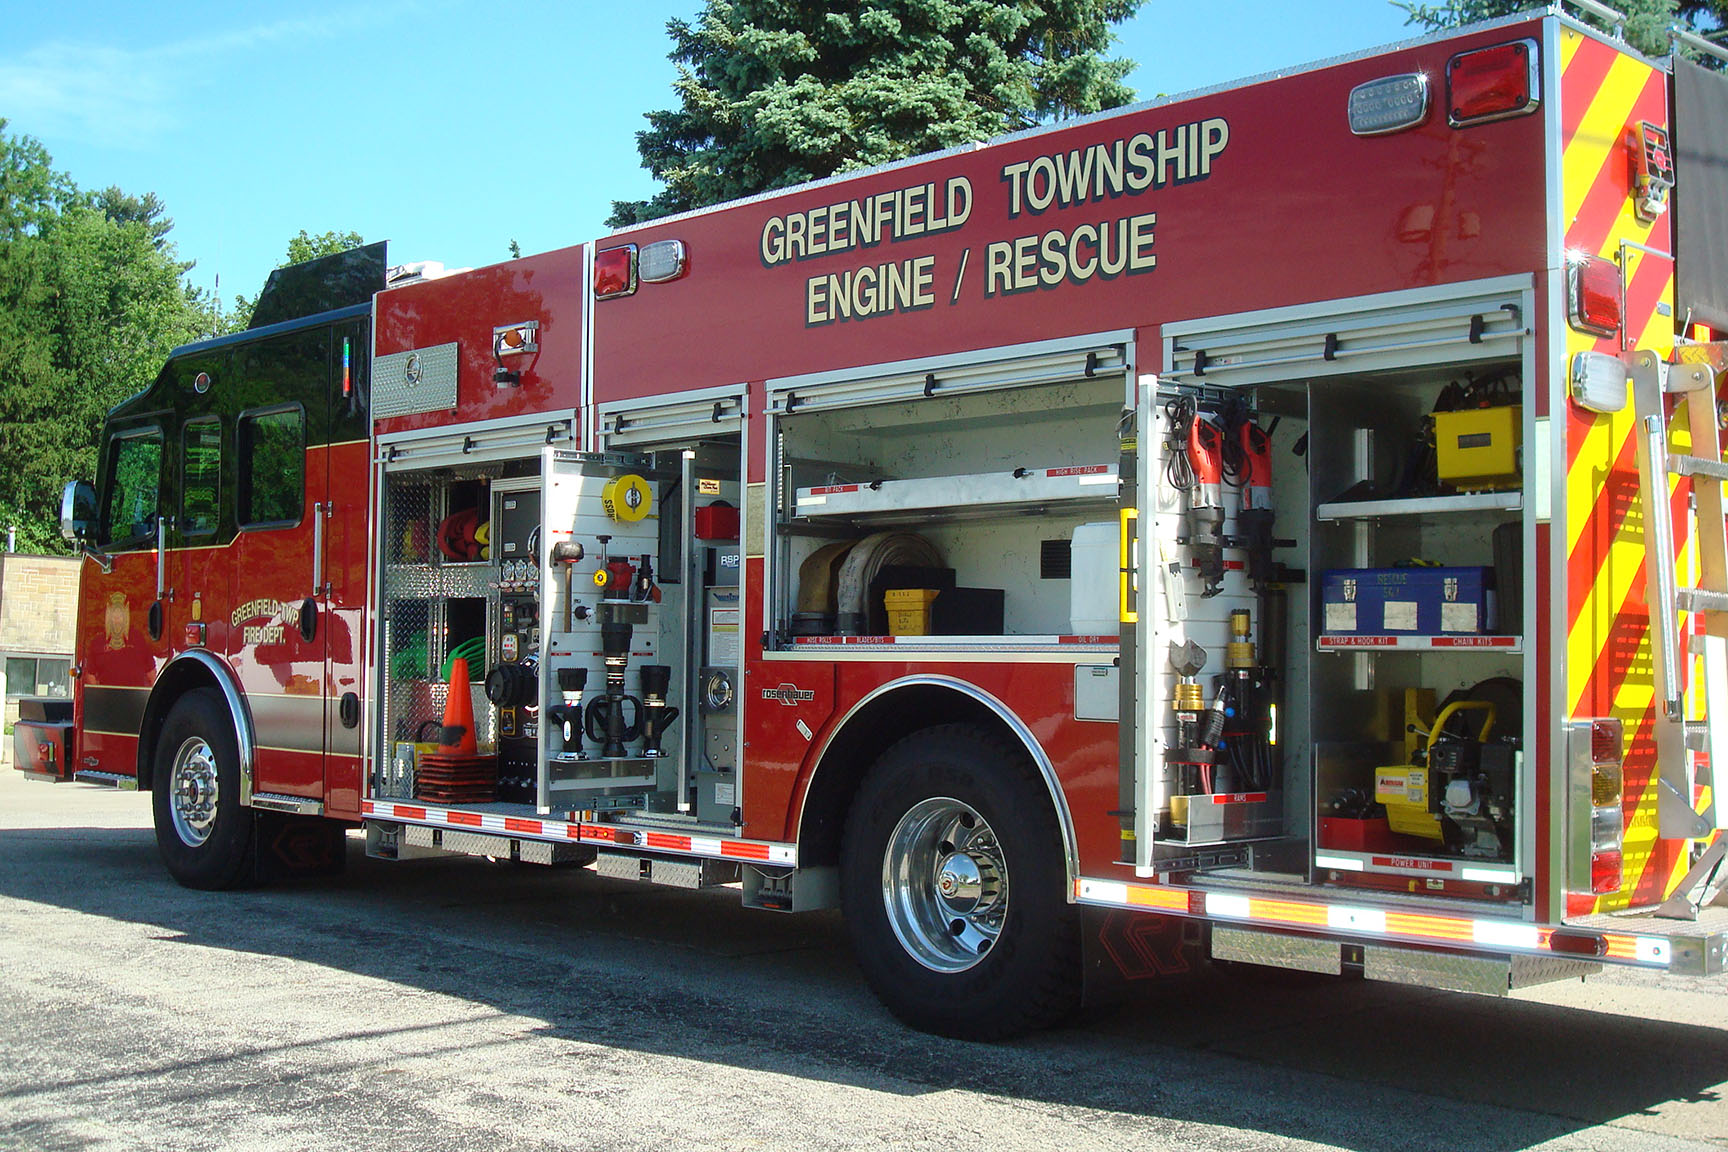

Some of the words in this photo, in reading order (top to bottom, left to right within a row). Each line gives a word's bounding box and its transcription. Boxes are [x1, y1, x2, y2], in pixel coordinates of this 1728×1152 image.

[761, 176, 974, 268] GREENFIELD
[1003, 117, 1230, 218] TOWNSHIP
[806, 255, 936, 327] ENGINE
[985, 213, 1158, 297] RESCUE
[1084, 465, 1098, 474] PACK
[231, 599, 279, 628] GREENFIELD
[280, 602, 299, 629] TWP.
[243, 626, 261, 644] FIRE
[262, 626, 287, 644] DEPT.
[1329, 637, 1349, 645] STRAP
[1357, 637, 1375, 645] HOOK
[1378, 637, 1389, 645] KIT
[1452, 638, 1474, 646] CHAIN
[1477, 638, 1493, 646] KITS
[761, 688, 815, 701] rosenbauer
[1391, 858, 1415, 868] POWER
[1417, 860, 1433, 869] UNIT
